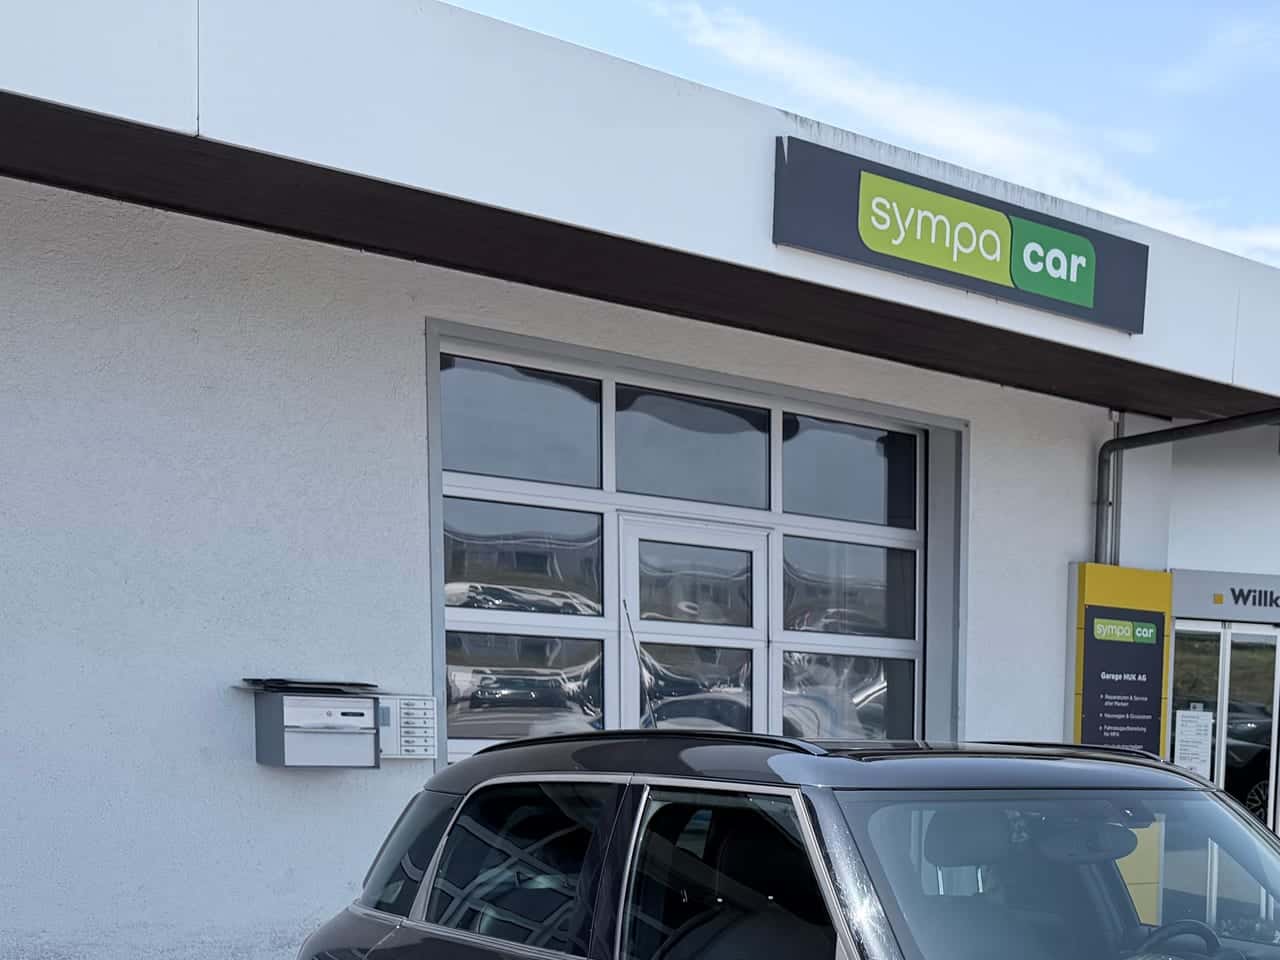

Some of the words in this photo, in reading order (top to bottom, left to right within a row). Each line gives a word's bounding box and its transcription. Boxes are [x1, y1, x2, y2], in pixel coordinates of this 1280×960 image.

[871, 196, 1001, 262] sympa
[1022, 241, 1087, 283] car
[1096, 622, 1131, 640] sympa
[1135, 627, 1154, 638] car
[1100, 671, 1123, 682] Garage
